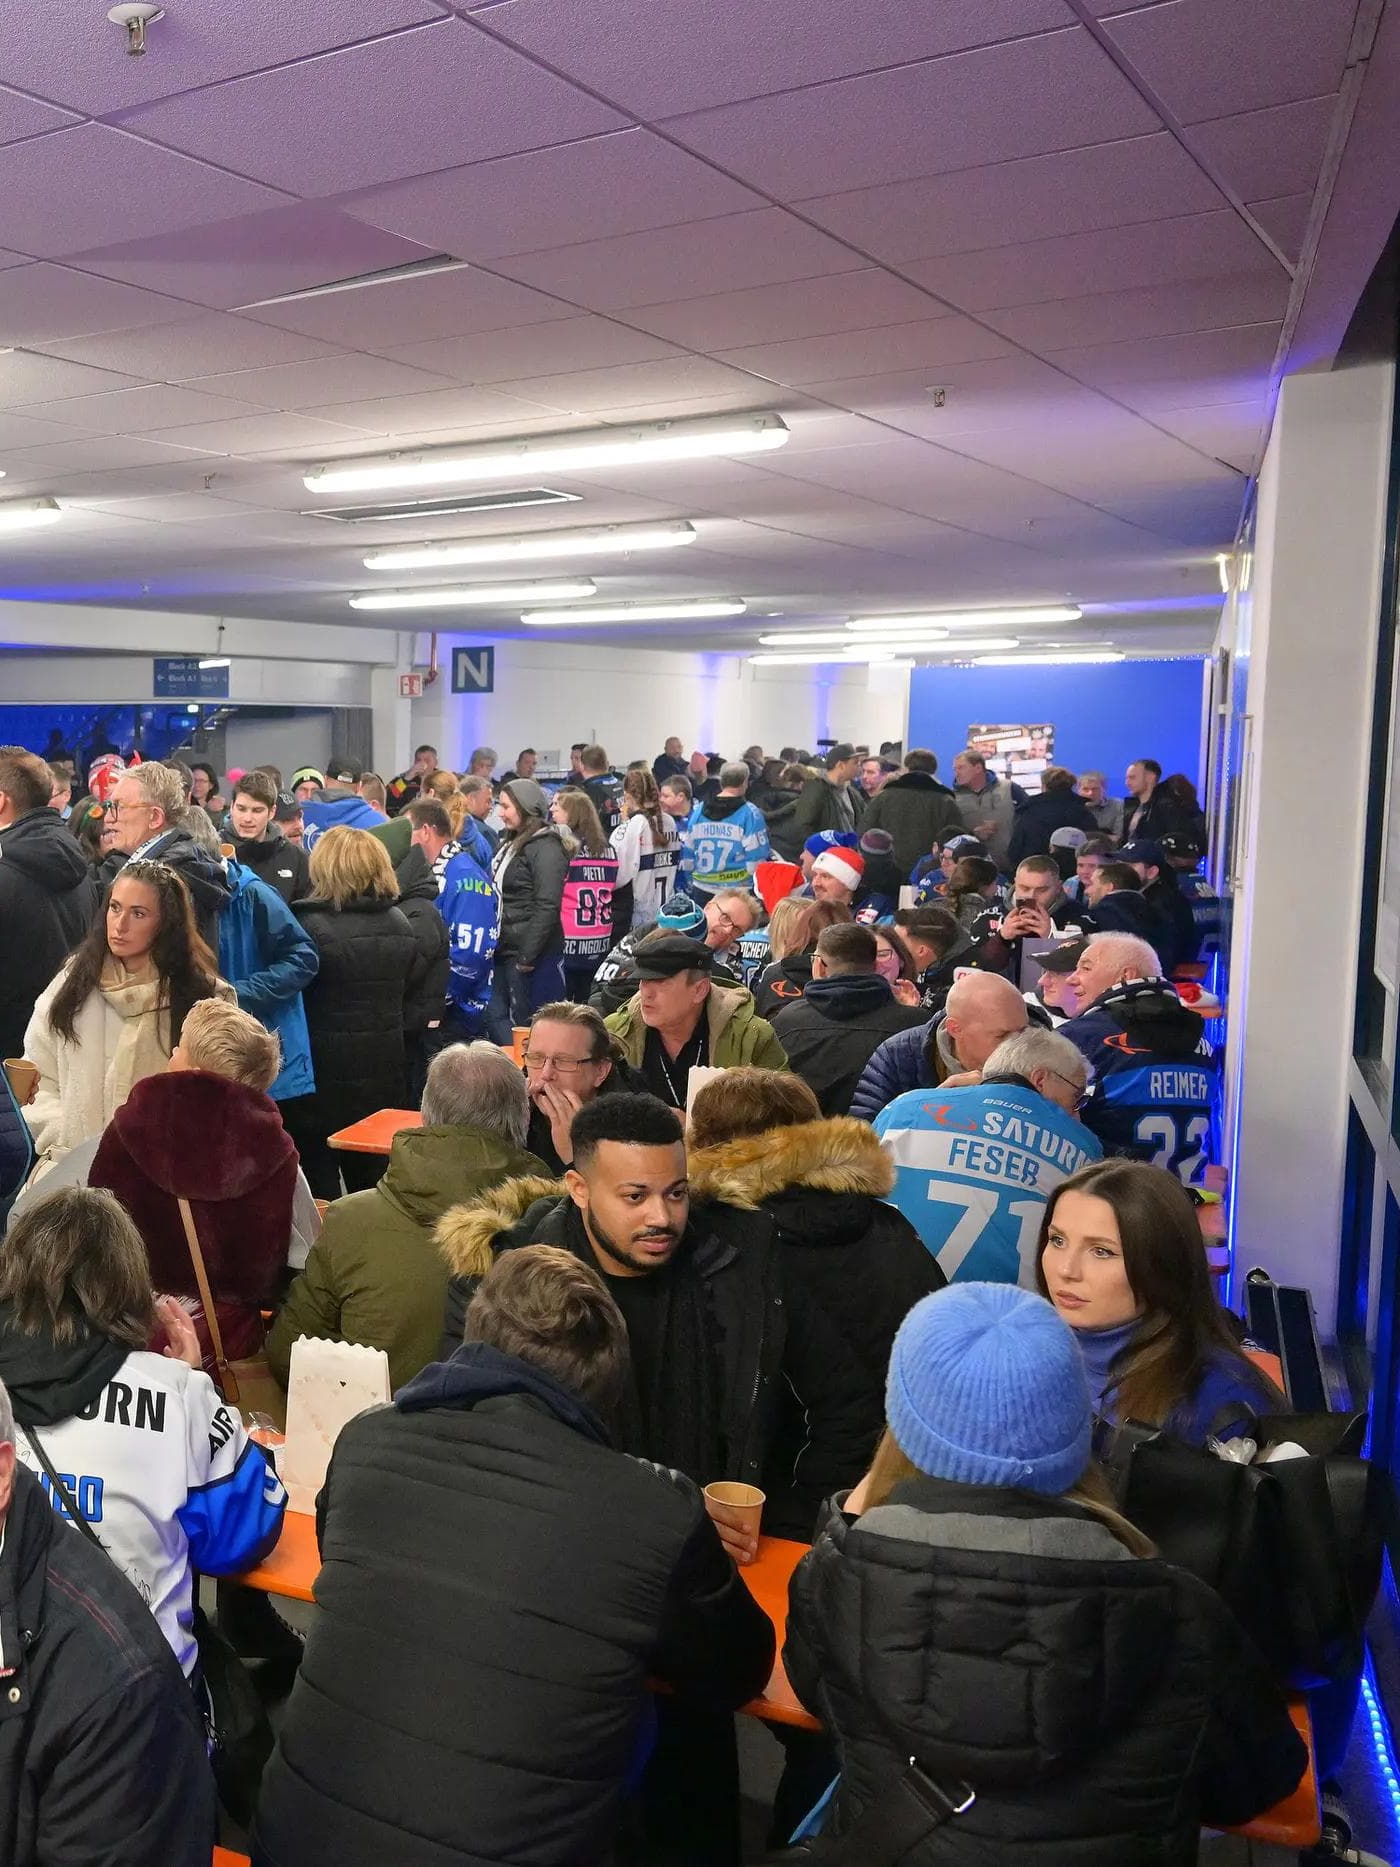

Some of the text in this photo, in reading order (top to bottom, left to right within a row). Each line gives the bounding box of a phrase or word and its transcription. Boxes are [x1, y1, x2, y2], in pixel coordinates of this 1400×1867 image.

[457, 652, 488, 689] N
[697, 840, 734, 874] 67
[457, 923, 484, 953] 51
[948, 1137, 1040, 1186] FESER
